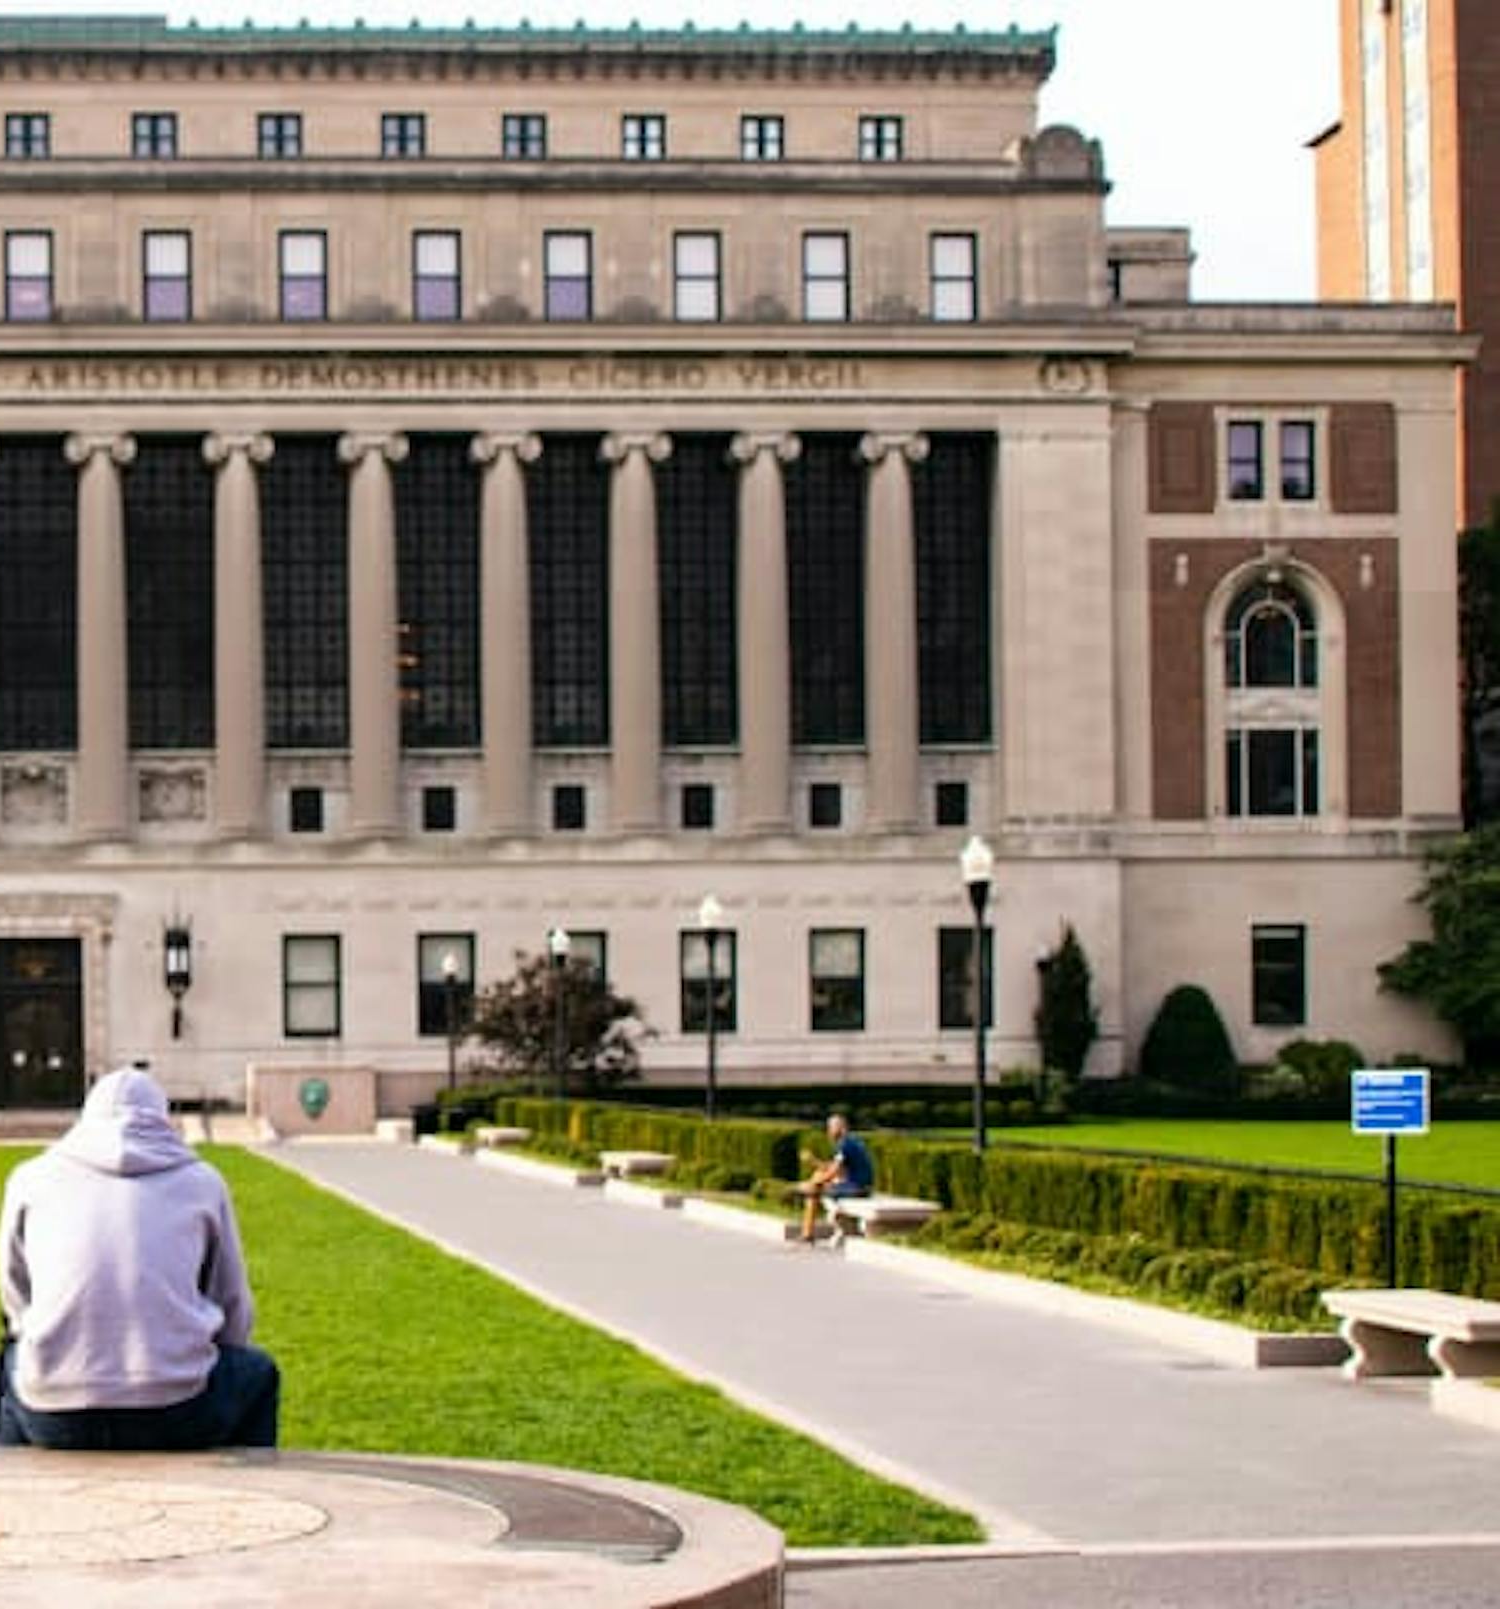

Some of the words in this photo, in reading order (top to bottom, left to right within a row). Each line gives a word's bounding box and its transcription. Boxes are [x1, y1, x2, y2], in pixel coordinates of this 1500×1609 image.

[27, 366, 226, 391] ARISTOTLE
[260, 365, 539, 390] DEMOSTHENES
[568, 364, 707, 390] CICERO
[737, 364, 867, 389] VERGIL
